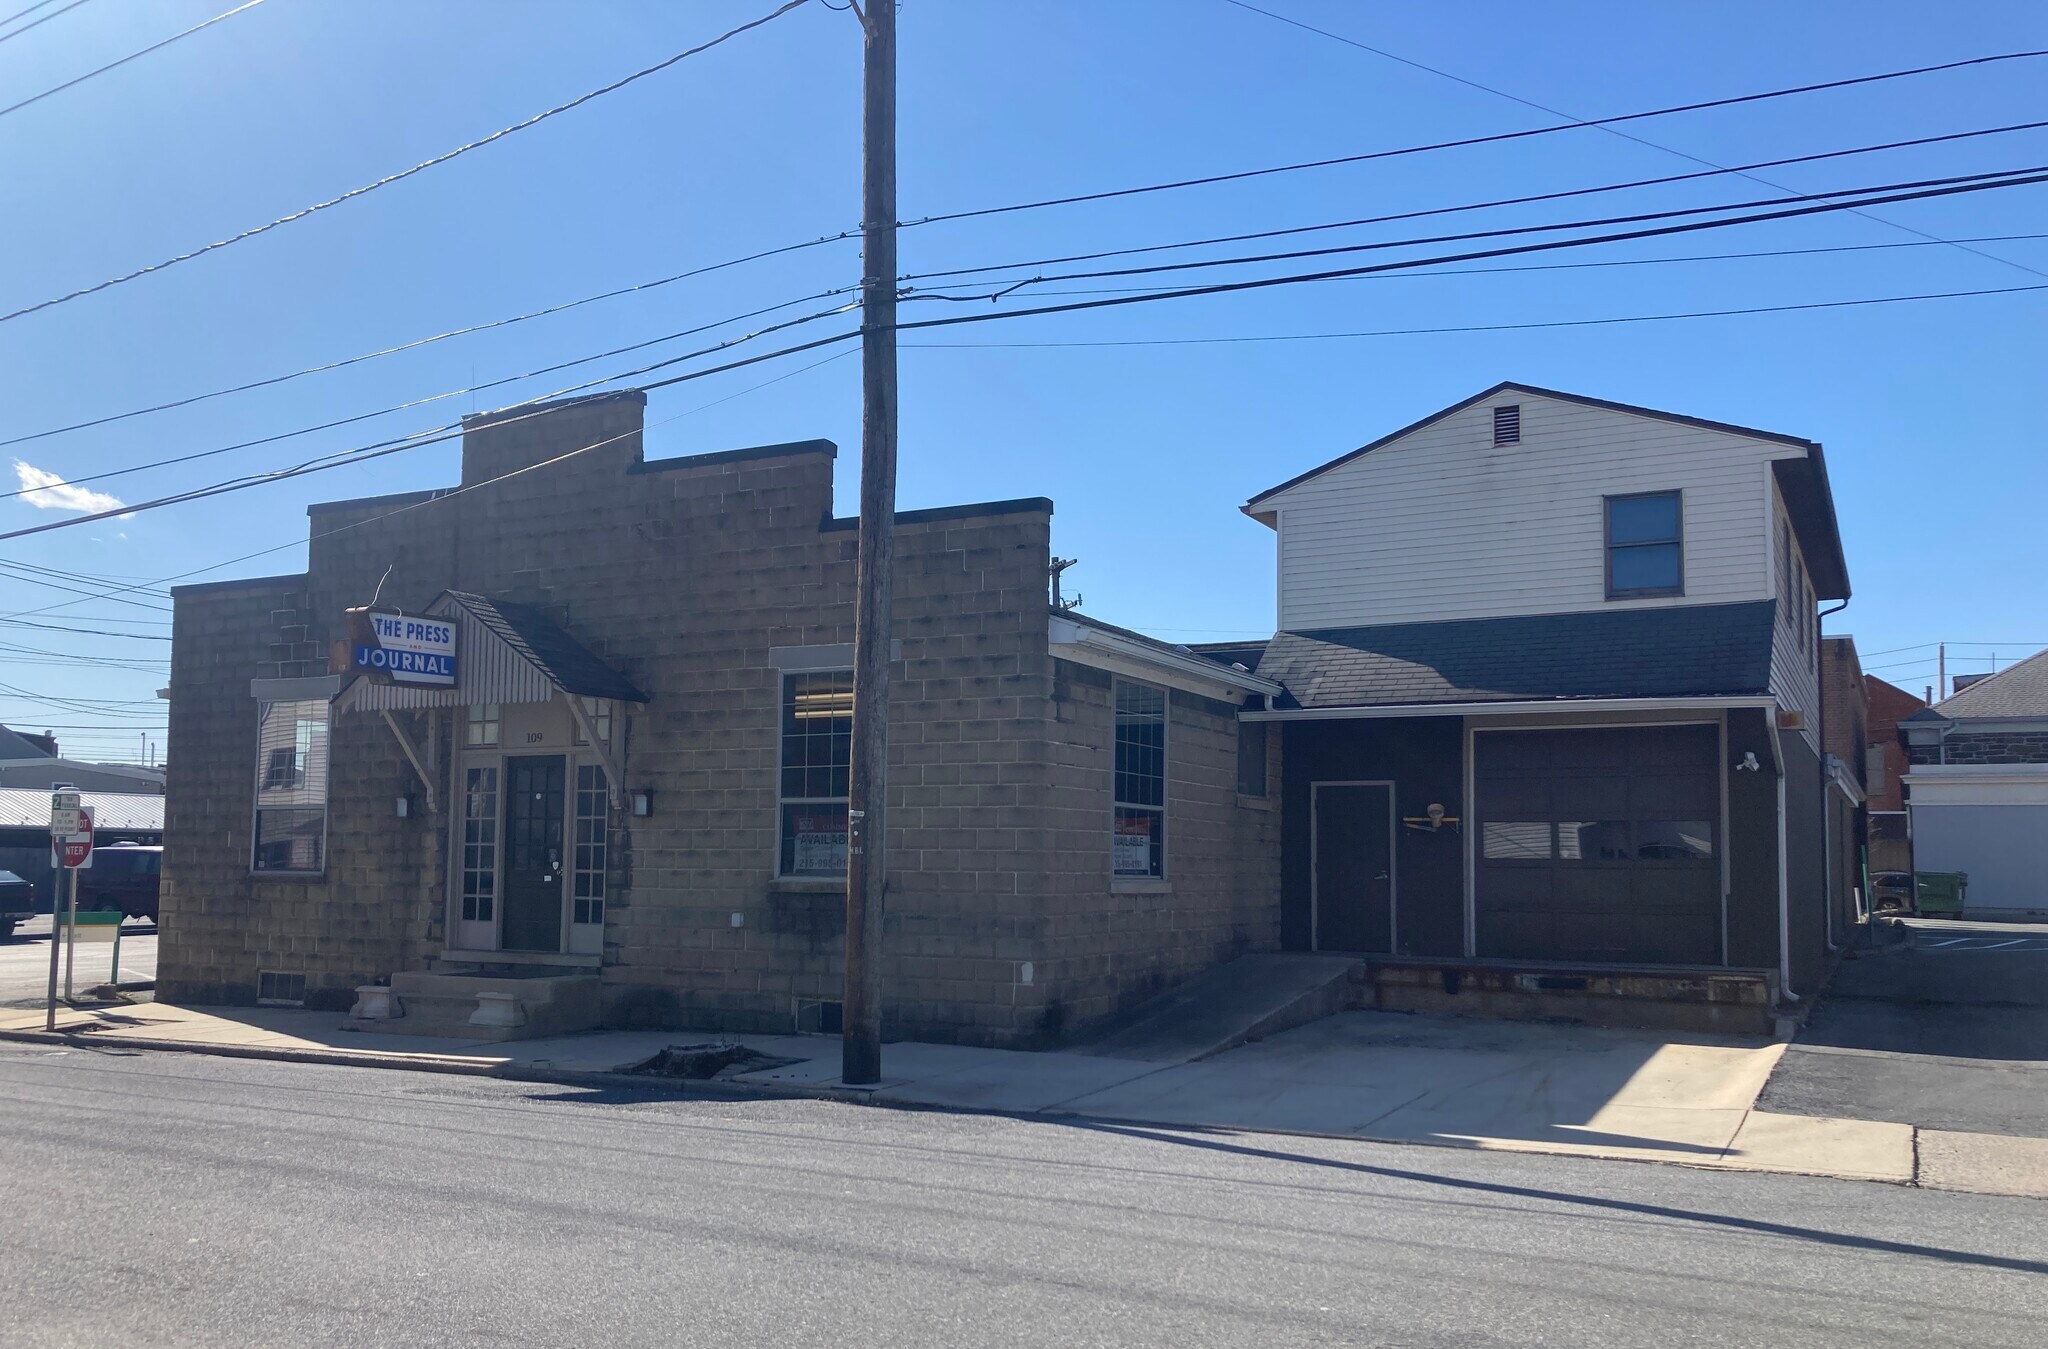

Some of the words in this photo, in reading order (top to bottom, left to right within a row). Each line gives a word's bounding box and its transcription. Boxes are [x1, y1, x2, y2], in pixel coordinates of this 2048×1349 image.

[375, 618, 402, 638] THE
[406, 622, 450, 644] PRESS
[358, 648, 449, 675] JOURNAL
[526, 732, 543, 743] 109
[53, 796, 60, 809] 2
[79, 819, 88, 829] OT
[800, 834, 849, 845] AVAILAB
[65, 846, 84, 855] NTER
